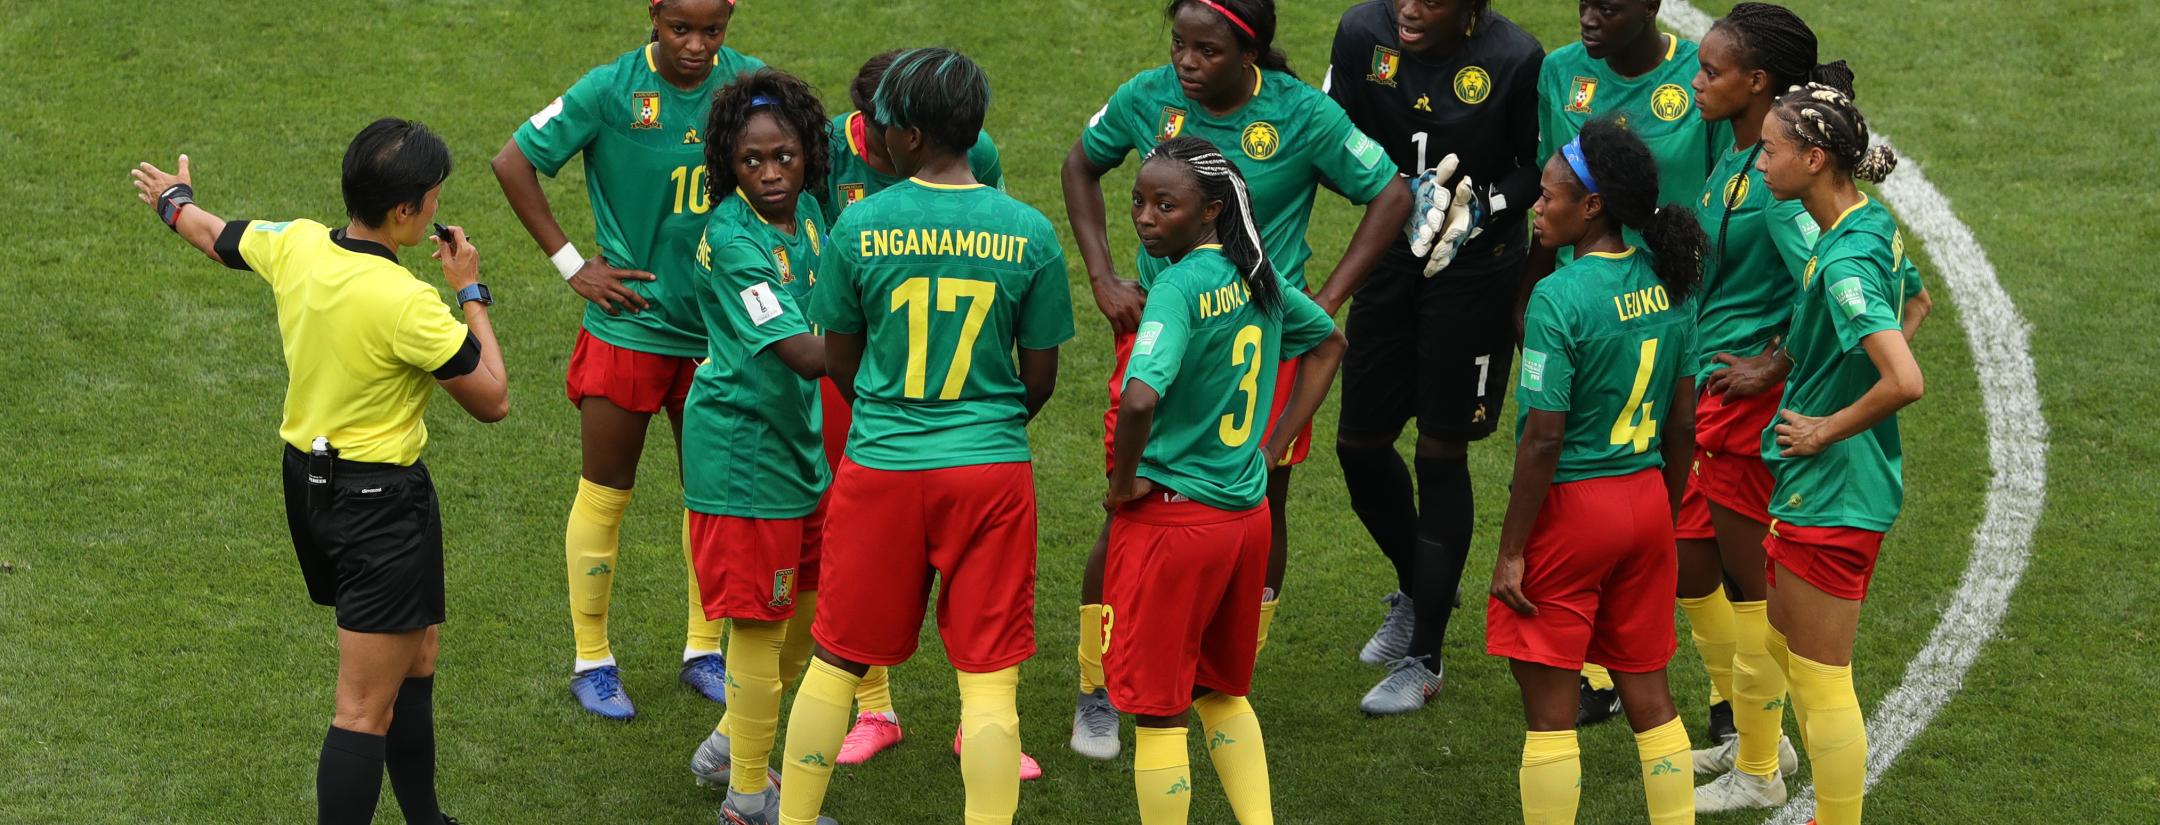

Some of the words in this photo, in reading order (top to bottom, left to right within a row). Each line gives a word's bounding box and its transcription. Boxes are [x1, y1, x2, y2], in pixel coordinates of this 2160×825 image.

[1411, 131, 1428, 175] 1
[671, 165, 711, 214] 10
[860, 228, 1028, 264] ENGANAMOUIT
[1199, 281, 1244, 319] NJOYA
[1614, 284, 1670, 322] LEUKO
[891, 277, 997, 401] 17
[1218, 324, 1262, 447] 3
[1475, 354, 1490, 397] 1
[1609, 338, 1658, 454] 4
[1101, 604, 1115, 655] 3
